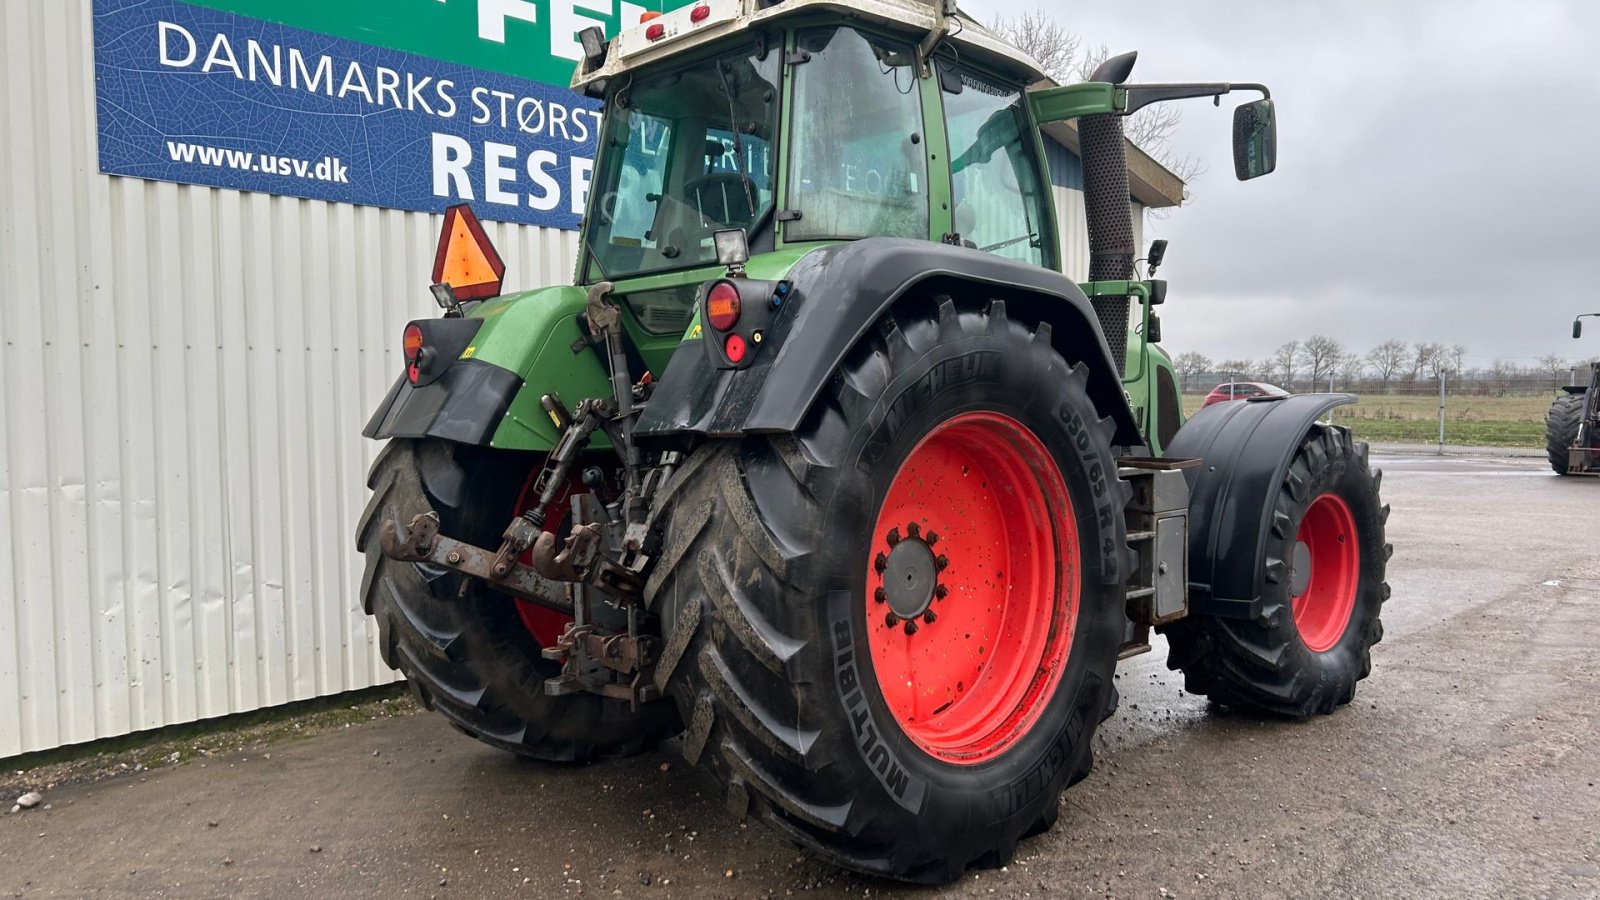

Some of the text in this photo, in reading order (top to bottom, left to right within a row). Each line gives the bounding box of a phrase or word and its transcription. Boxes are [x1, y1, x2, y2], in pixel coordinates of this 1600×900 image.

[158, 20, 456, 118] DANMARKS
[167, 140, 349, 184] www.usv.dk
[1059, 401, 1107, 499] 650/65
[834, 619, 911, 800] MULTIBIB
